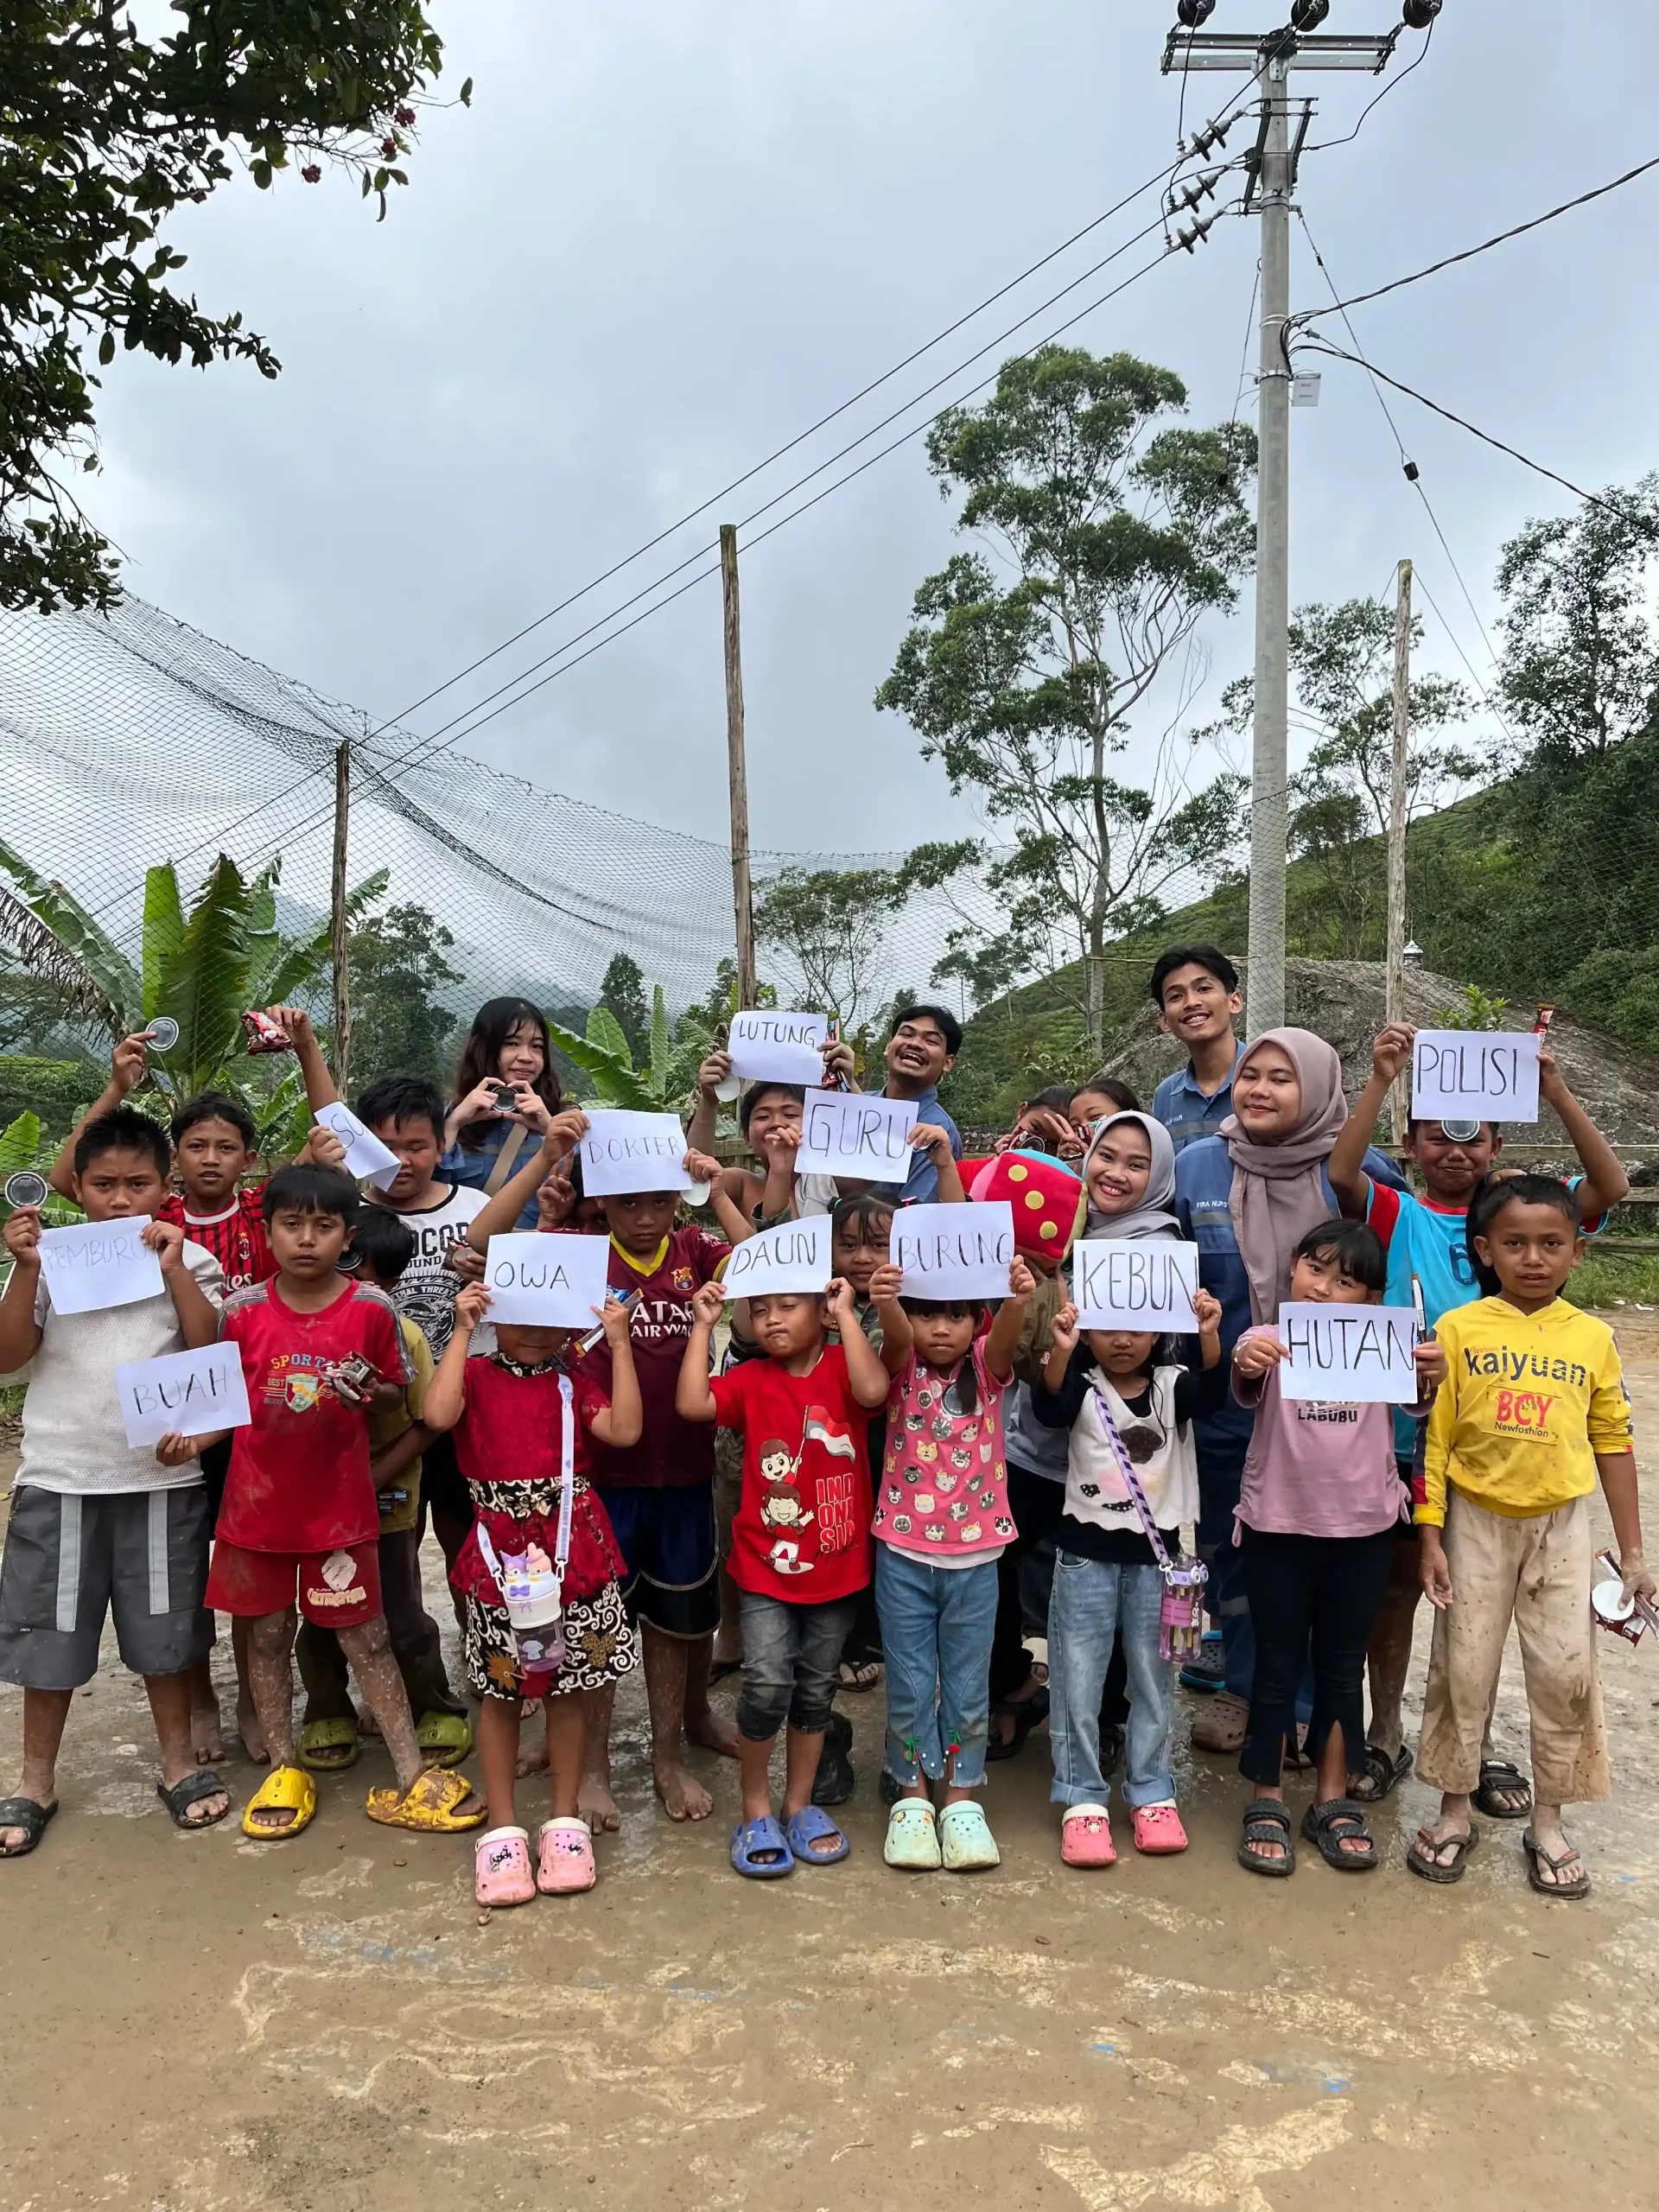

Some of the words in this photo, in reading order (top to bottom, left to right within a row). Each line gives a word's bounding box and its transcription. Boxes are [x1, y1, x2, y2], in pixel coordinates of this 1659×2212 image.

[739, 1020, 817, 1048] LUTUNG
[1417, 1043, 1518, 1096] POLISI
[809, 1103, 910, 1159] GURU
[588, 1135, 684, 1165] DOKTER
[43, 1236, 147, 1273] PEMBURU
[731, 1232, 817, 1276] DAUN
[898, 1231, 1011, 1274] BURUNG
[421, 1286, 456, 1298] THREAT
[494, 1262, 570, 1289] OWA
[1082, 1250, 1198, 1315] KEBUN
[629, 1300, 695, 1324] ATAR
[270, 1353, 327, 1370] SPORT
[1287, 1318, 1415, 1371] HUTAN
[1464, 1345, 1586, 1388] kaiyuan
[132, 1363, 228, 1414] BUAH
[1297, 1407, 1358, 1423] LABUBU
[1494, 1421, 1550, 1439] Newfashion
